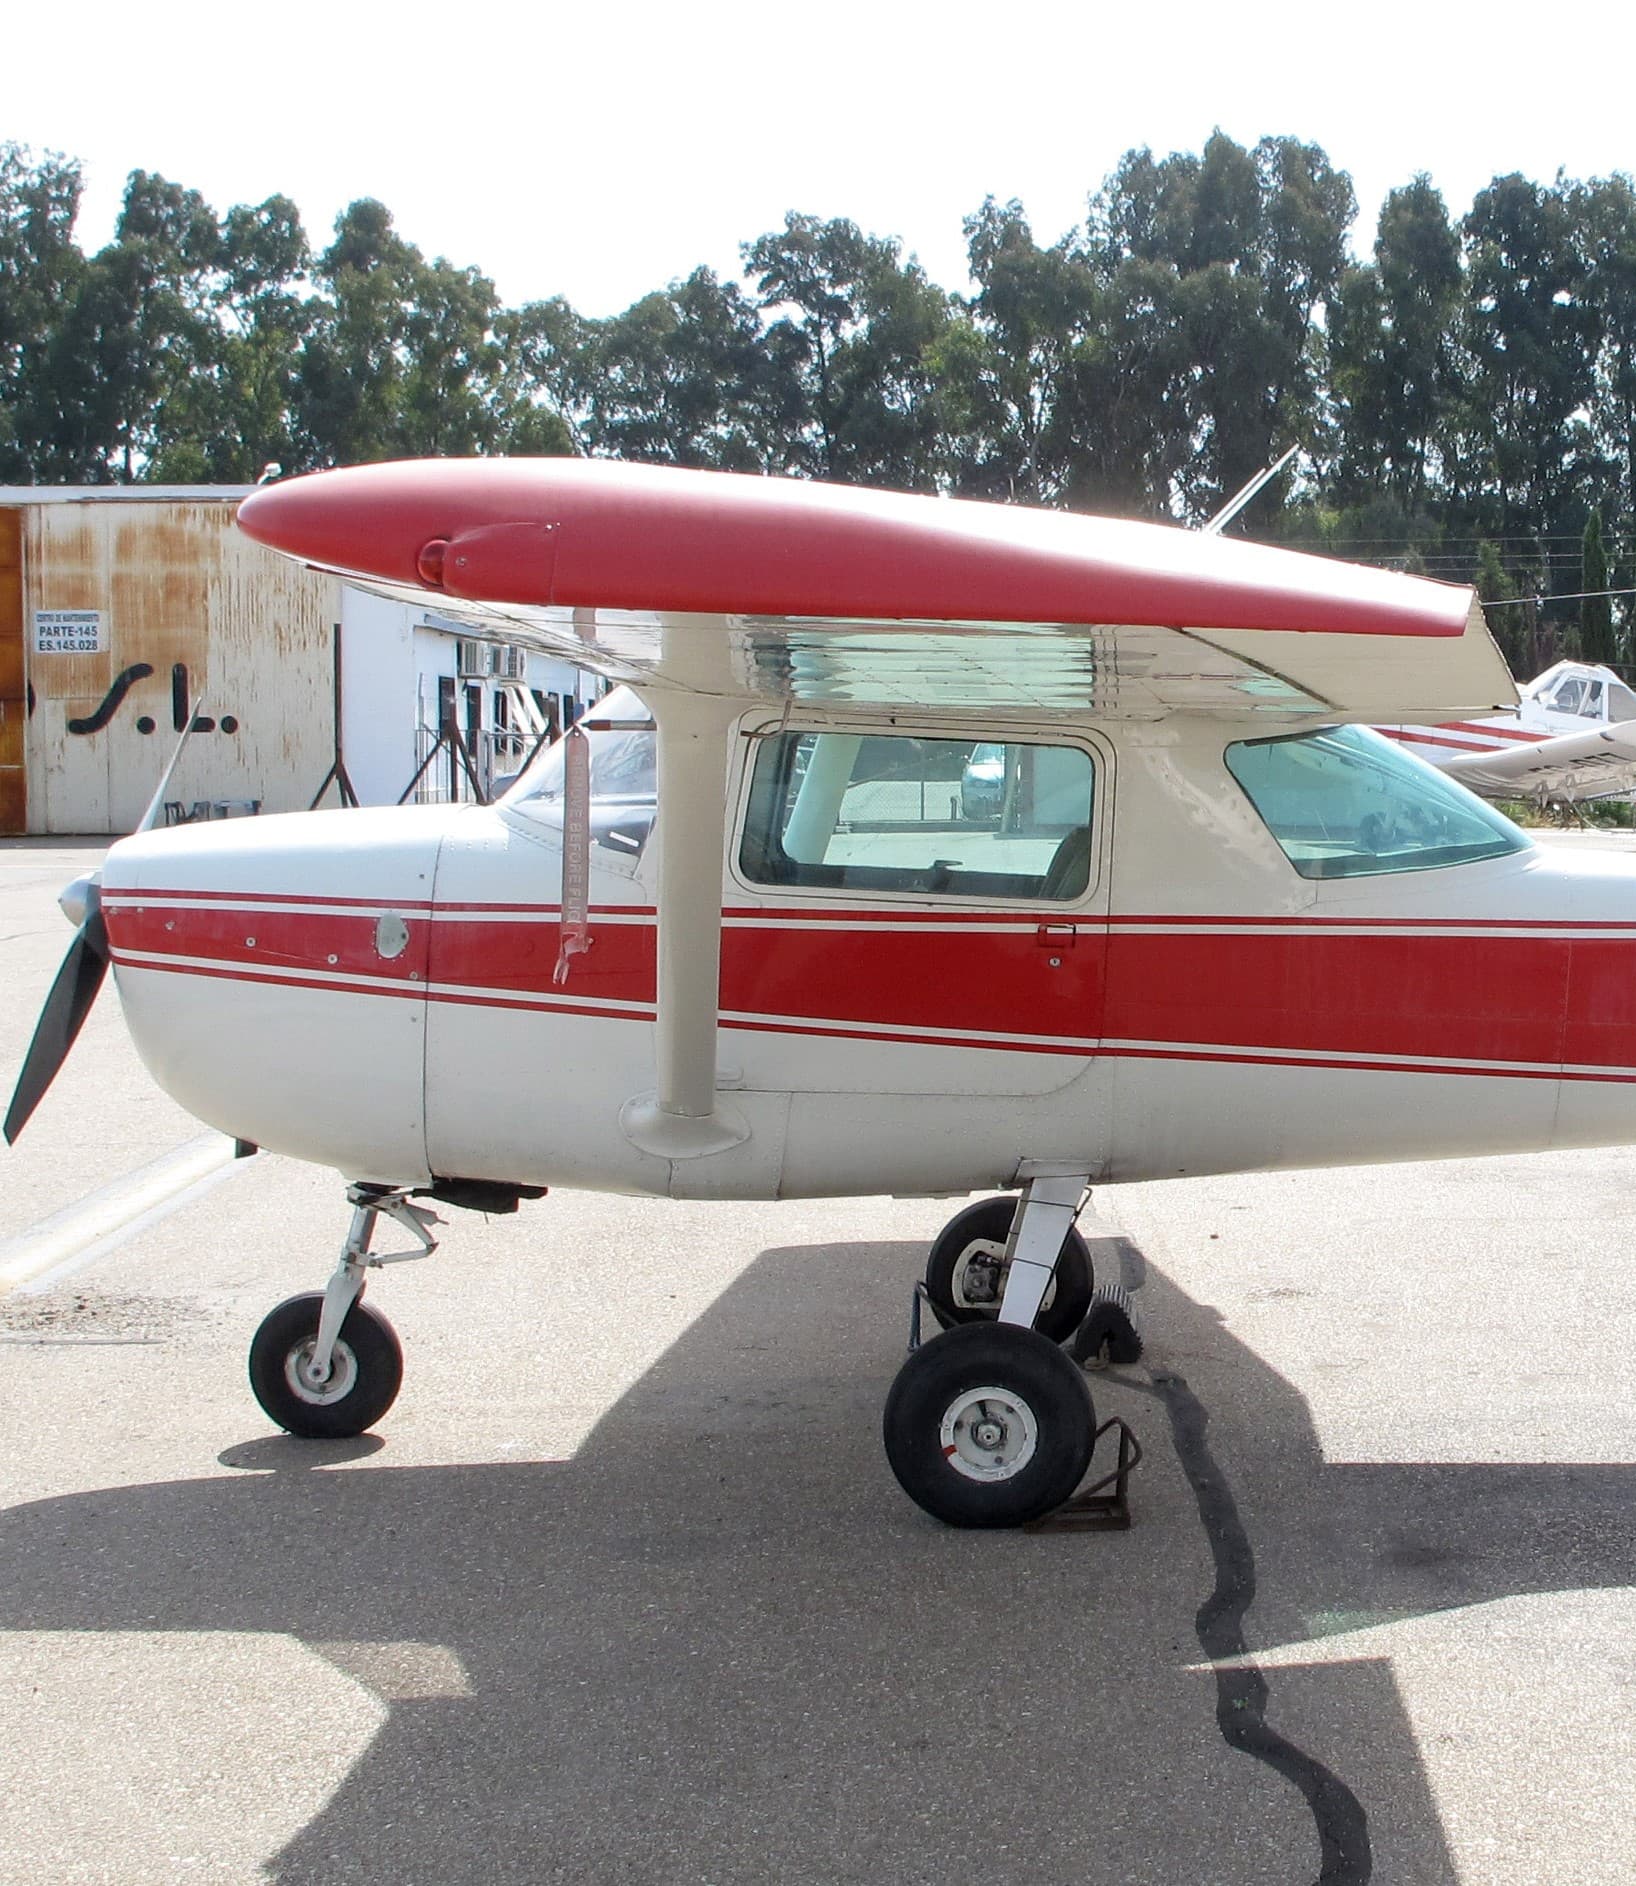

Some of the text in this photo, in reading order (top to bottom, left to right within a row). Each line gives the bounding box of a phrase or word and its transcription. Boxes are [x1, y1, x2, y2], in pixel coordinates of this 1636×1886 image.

[39, 626, 98, 637] PARTE-145
[39, 640, 98, 651] ES.145.028
[568, 823, 582, 884] BEFORE
